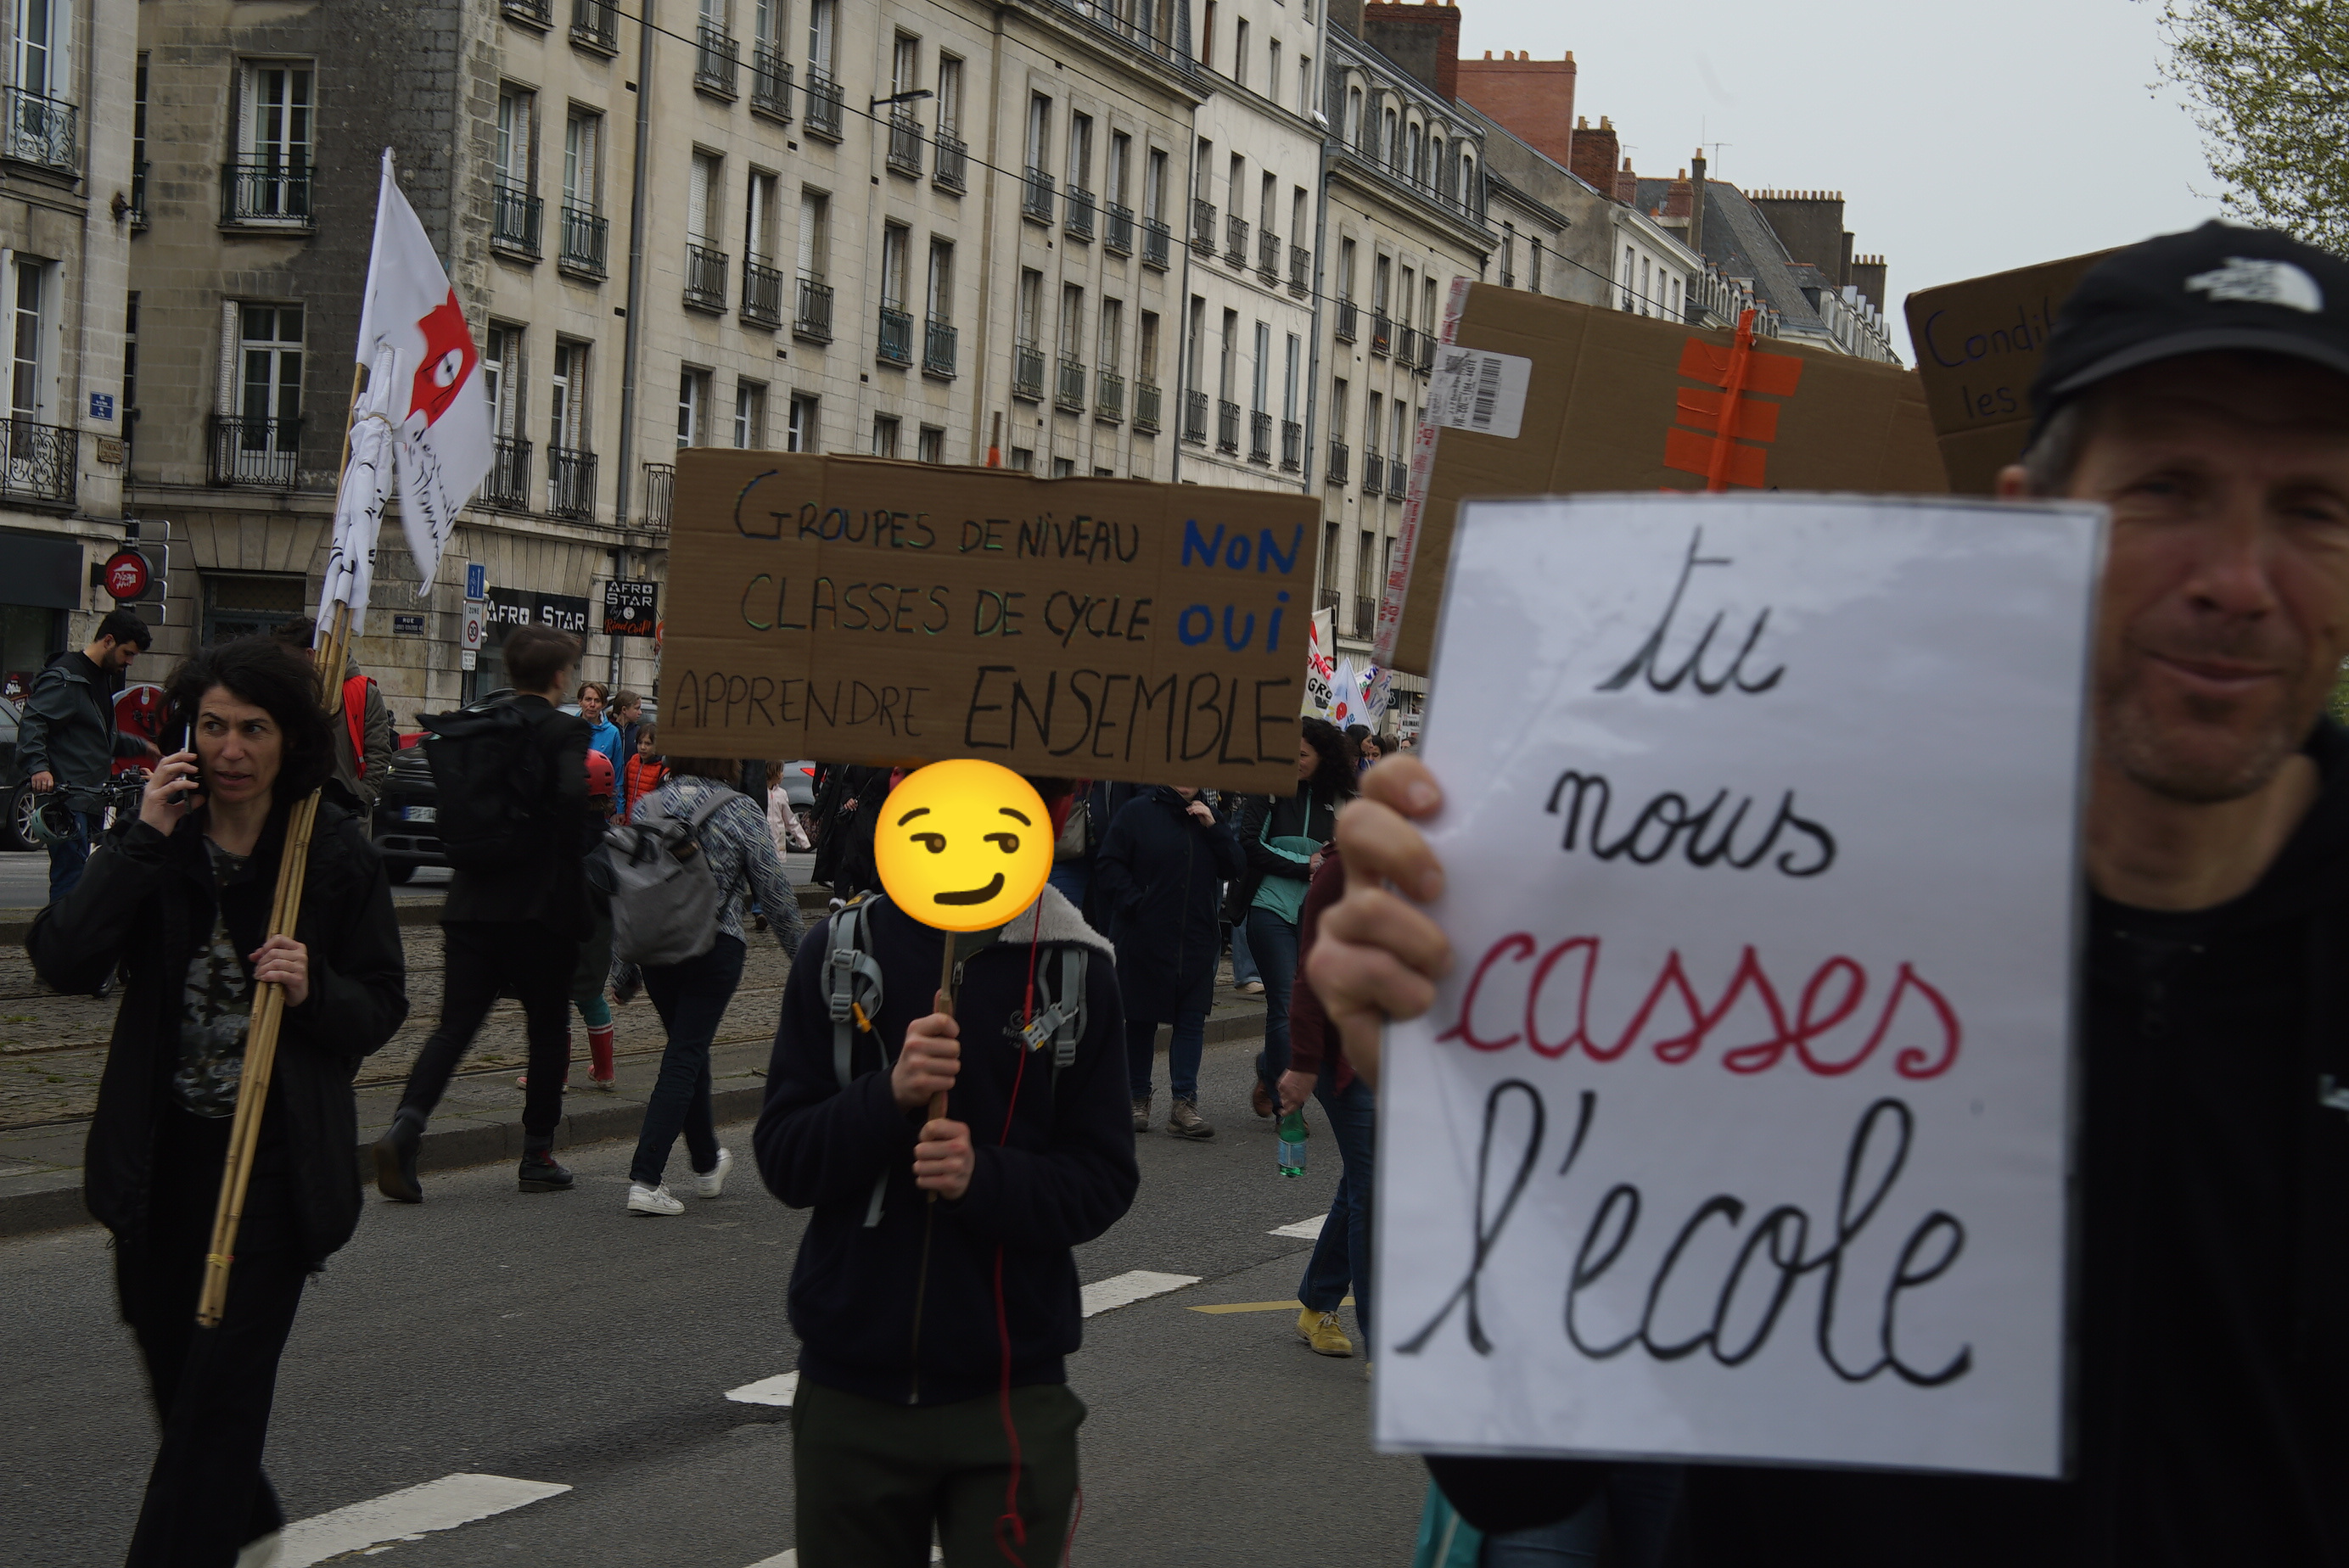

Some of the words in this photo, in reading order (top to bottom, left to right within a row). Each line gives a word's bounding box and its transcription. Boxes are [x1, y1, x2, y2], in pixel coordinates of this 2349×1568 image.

[1962, 384, 2018, 419] les
[734, 468, 936, 550] GROUPES
[959, 518, 1007, 554] DE
[486, 599, 531, 626] AFRO
[541, 605, 586, 632] STAR
[605, 592, 653, 608] STAR
[608, 580, 653, 595] AFRO
[741, 573, 951, 637] CLASSES
[973, 589, 1028, 638] DE
[1045, 590, 1152, 648] CYCLE
[1594, 524, 1788, 698] tu
[469, 625, 477, 637] 30
[670, 669, 931, 738] APPRENDRE
[964, 664, 1297, 766] ENSEMBLE
[1545, 768, 1838, 878] nous
[1435, 931, 1963, 1081] casses
[1393, 1078, 1973, 1389] l'ecole
